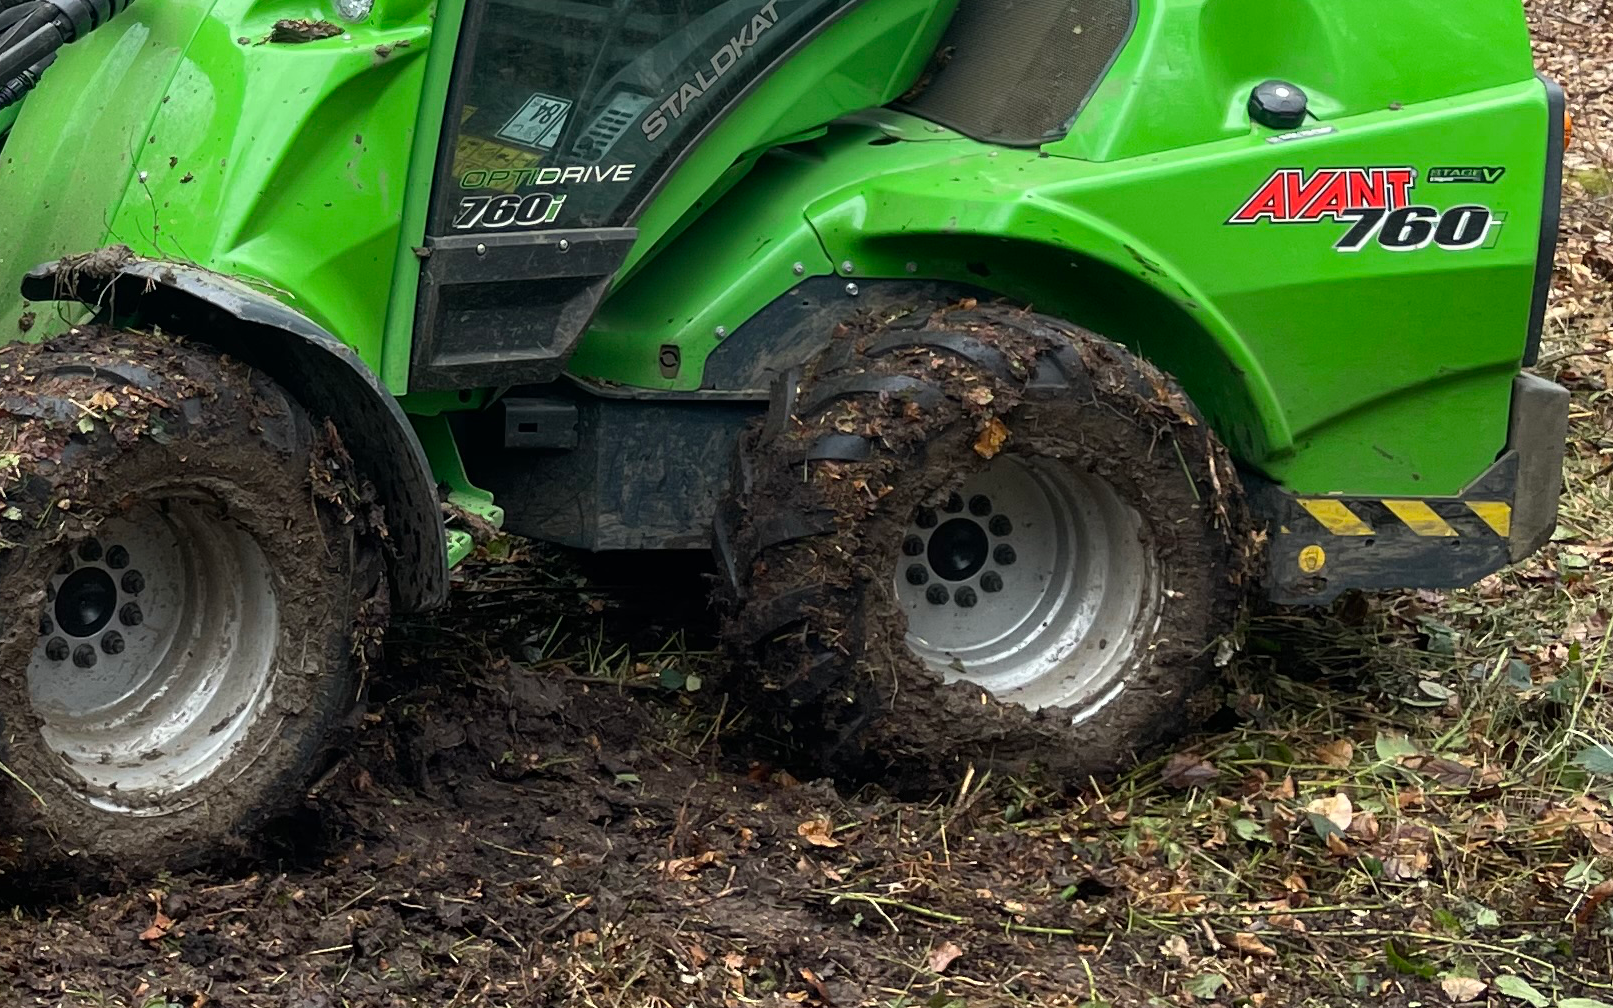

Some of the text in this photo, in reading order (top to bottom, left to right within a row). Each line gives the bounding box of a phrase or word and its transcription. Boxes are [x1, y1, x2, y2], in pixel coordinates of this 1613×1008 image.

[460, 163, 637, 190] OPTIDRIVE
[1224, 167, 1414, 224] AVANT
[452, 193, 568, 229] 760i
[1332, 204, 1509, 253] 760i
